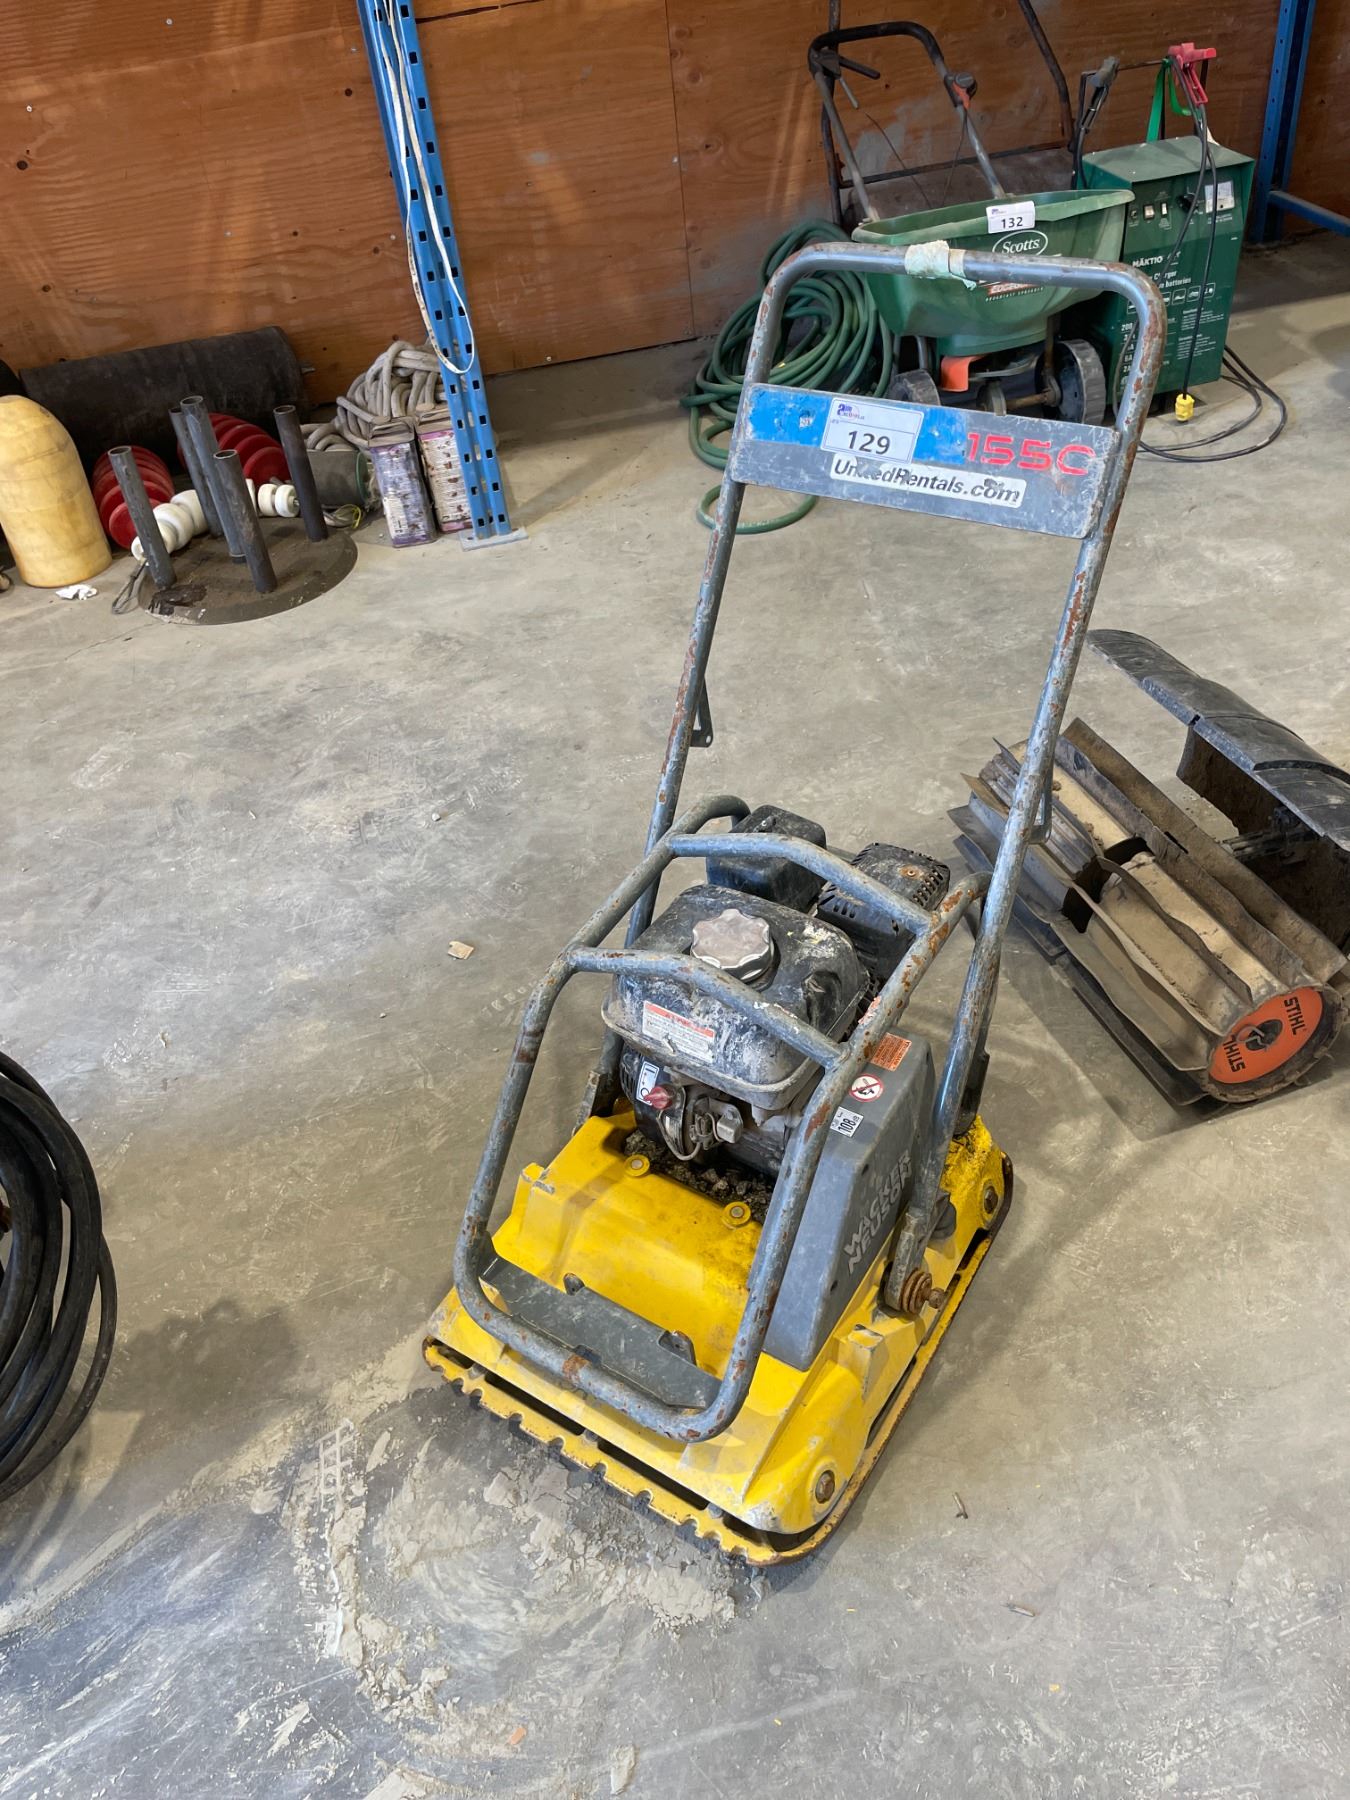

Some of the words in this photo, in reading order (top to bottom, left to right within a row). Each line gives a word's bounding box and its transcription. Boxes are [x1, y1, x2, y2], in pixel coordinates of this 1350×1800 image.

[1001, 216, 1023, 229] 132
[1002, 239, 1040, 254] Scotts
[848, 430, 890, 455] 129
[1284, 996, 1306, 1036] STIHL
[1223, 1035, 1246, 1073] STIHL
[838, 1118, 857, 1133] 108
[844, 1150, 911, 1256] WACKER
[849, 1161, 912, 1274] NEUSON
